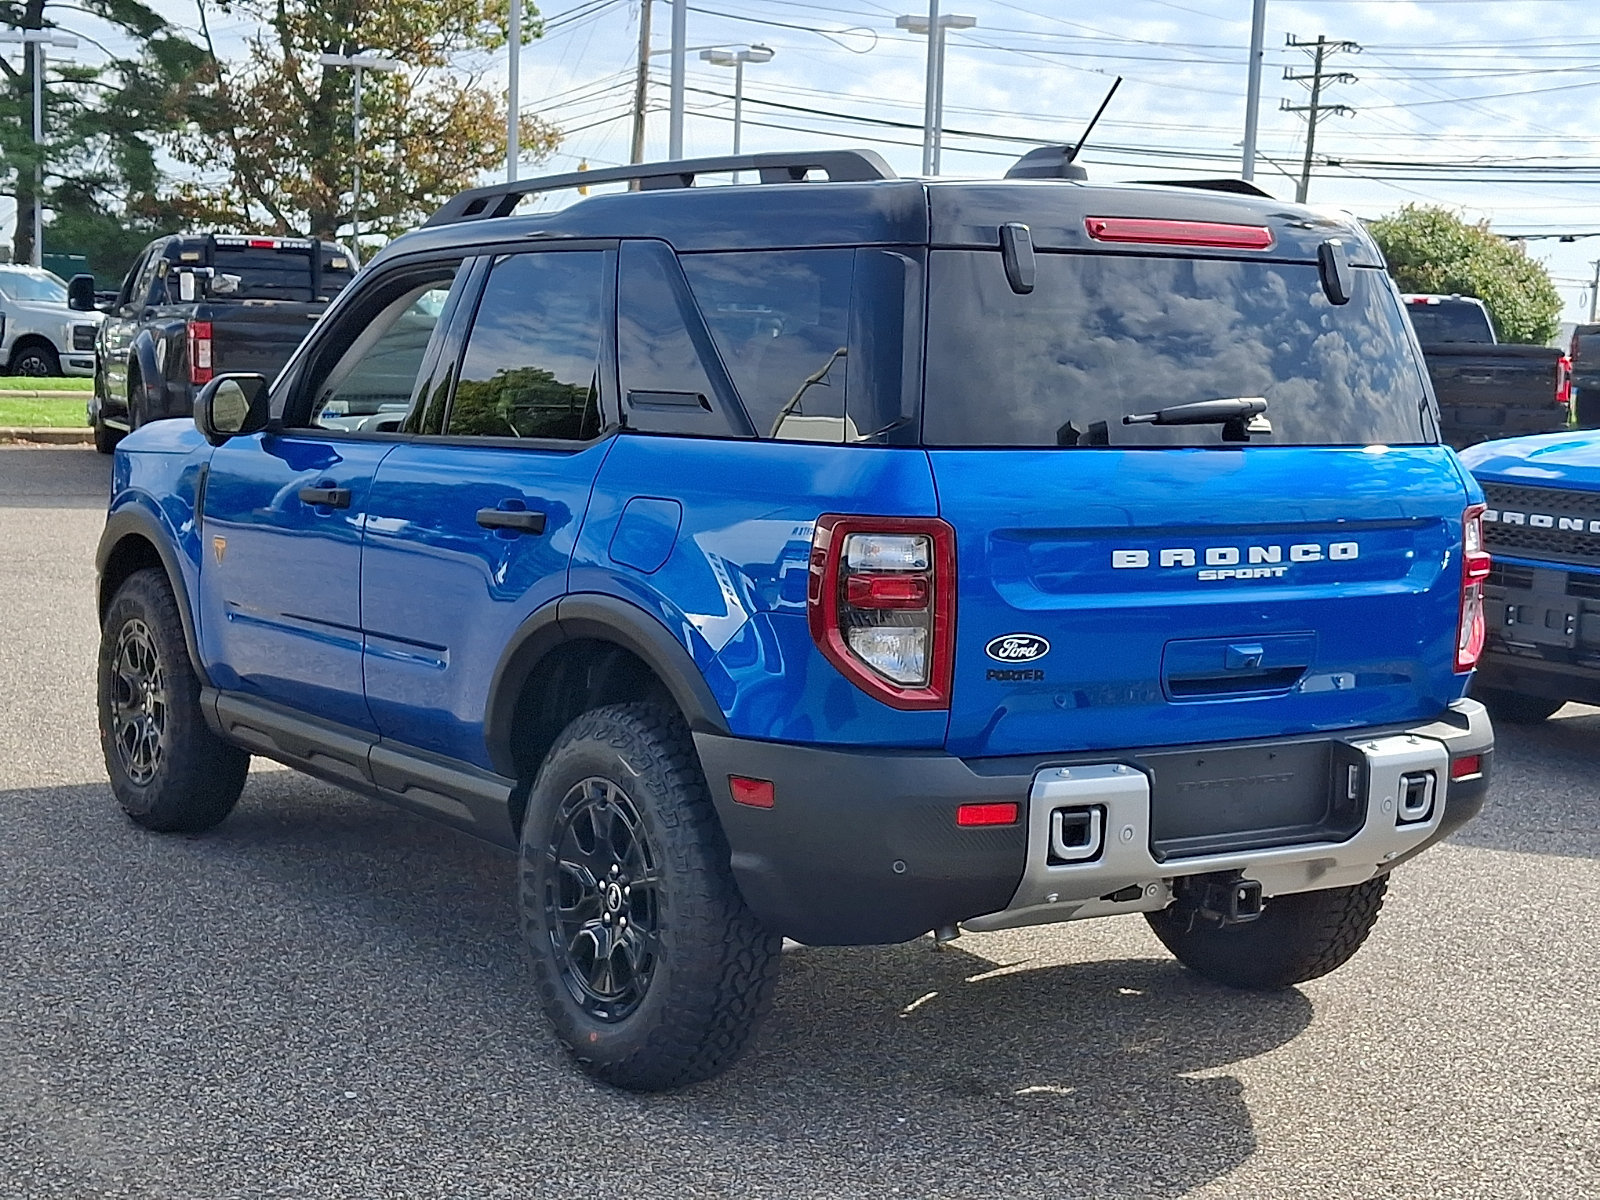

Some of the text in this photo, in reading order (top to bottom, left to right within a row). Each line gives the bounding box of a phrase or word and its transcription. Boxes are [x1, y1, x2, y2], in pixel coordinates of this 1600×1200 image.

[1112, 542, 1359, 568] BRONCO
[1198, 567, 1289, 581] SPORT
[998, 638, 1039, 657] Ford
[986, 669, 1045, 681] PORTER
